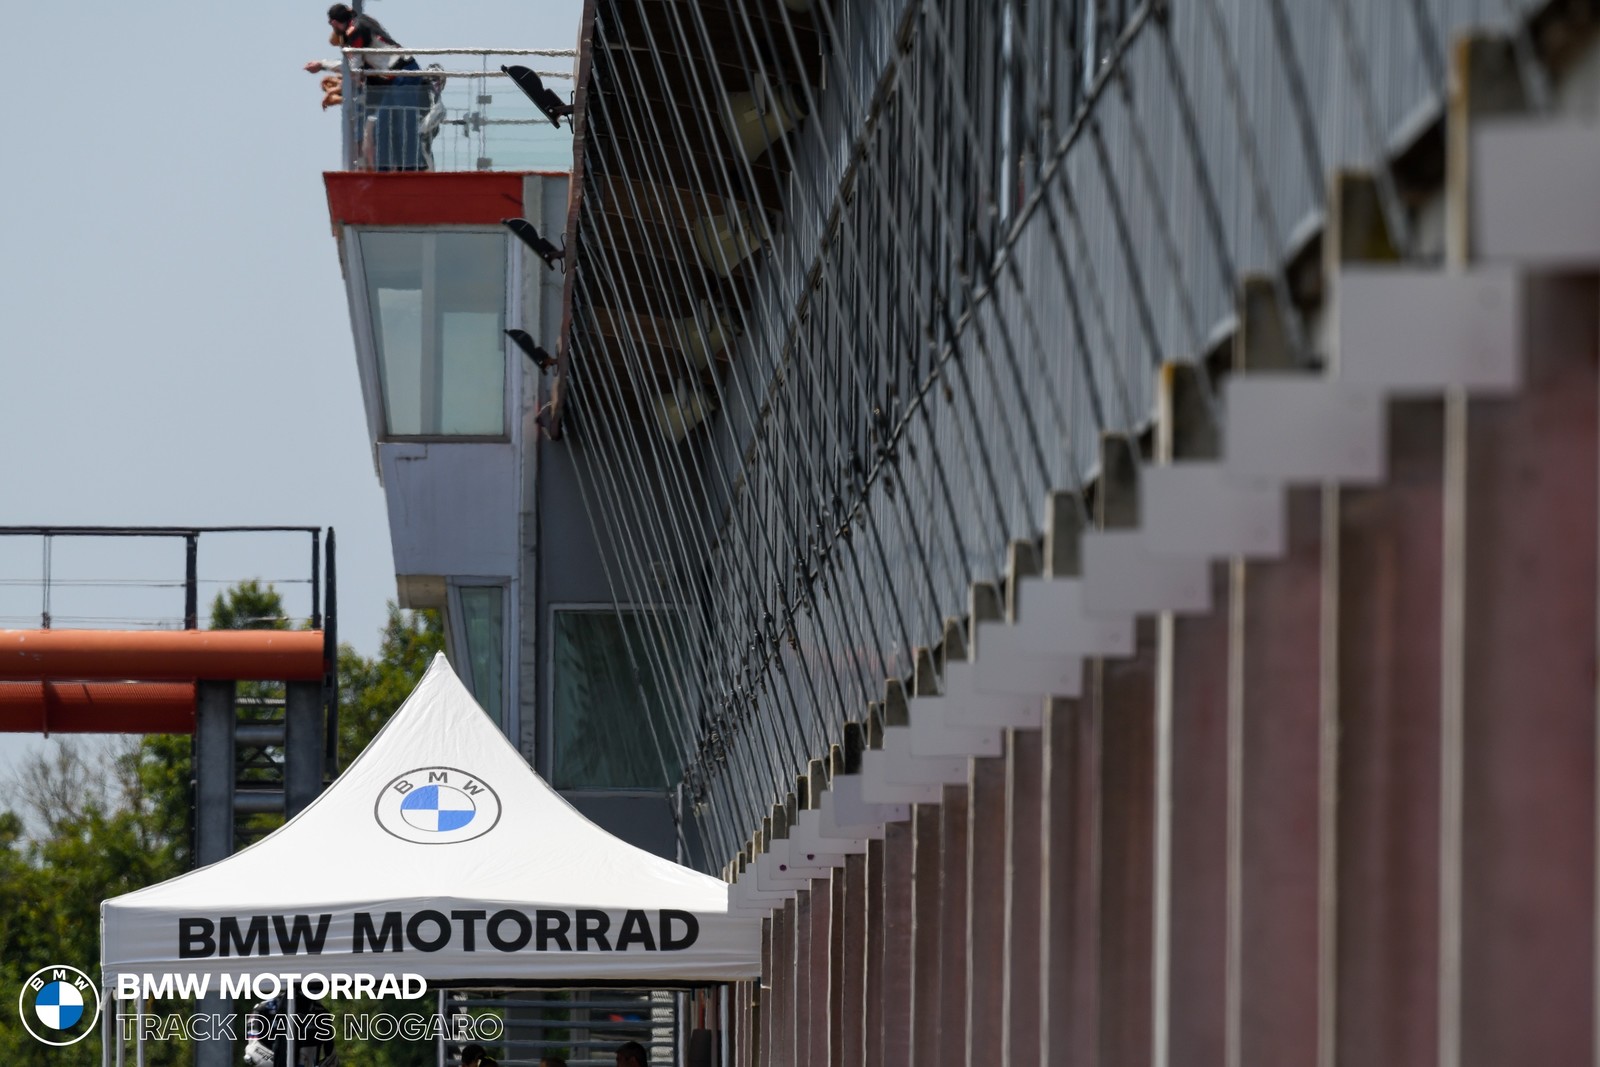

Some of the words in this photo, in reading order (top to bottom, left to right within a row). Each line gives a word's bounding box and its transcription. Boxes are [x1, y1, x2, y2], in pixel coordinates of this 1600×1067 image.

[394, 772, 485, 795] BMW
[179, 914, 331, 959] BMW
[352, 909, 699, 953] MOTORRAD
